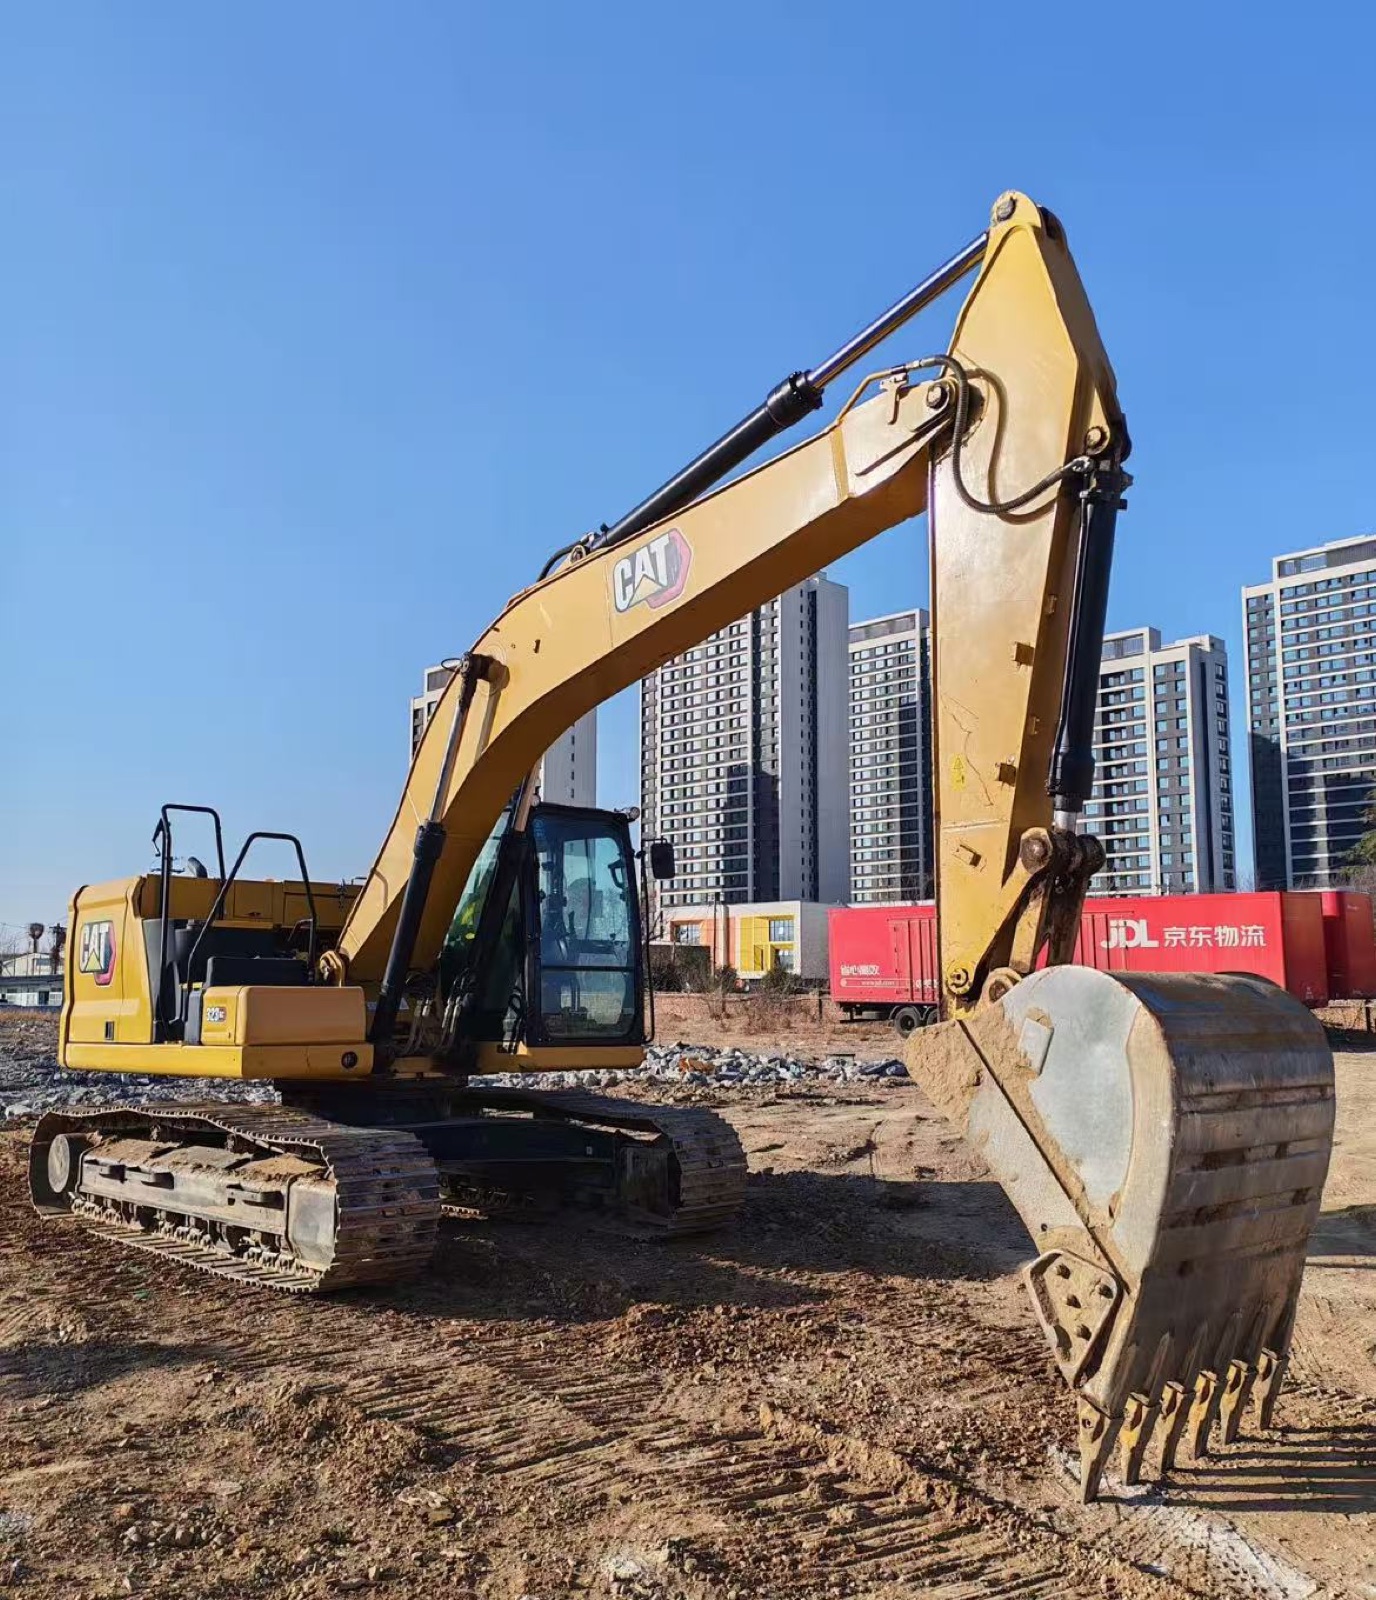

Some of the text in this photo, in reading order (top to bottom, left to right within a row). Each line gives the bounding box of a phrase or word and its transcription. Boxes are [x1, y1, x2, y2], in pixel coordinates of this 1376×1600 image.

[613, 533, 670, 612] CAT
[80, 923, 109, 972] CAT
[1100, 919, 1267, 949] JDL 京东物流
